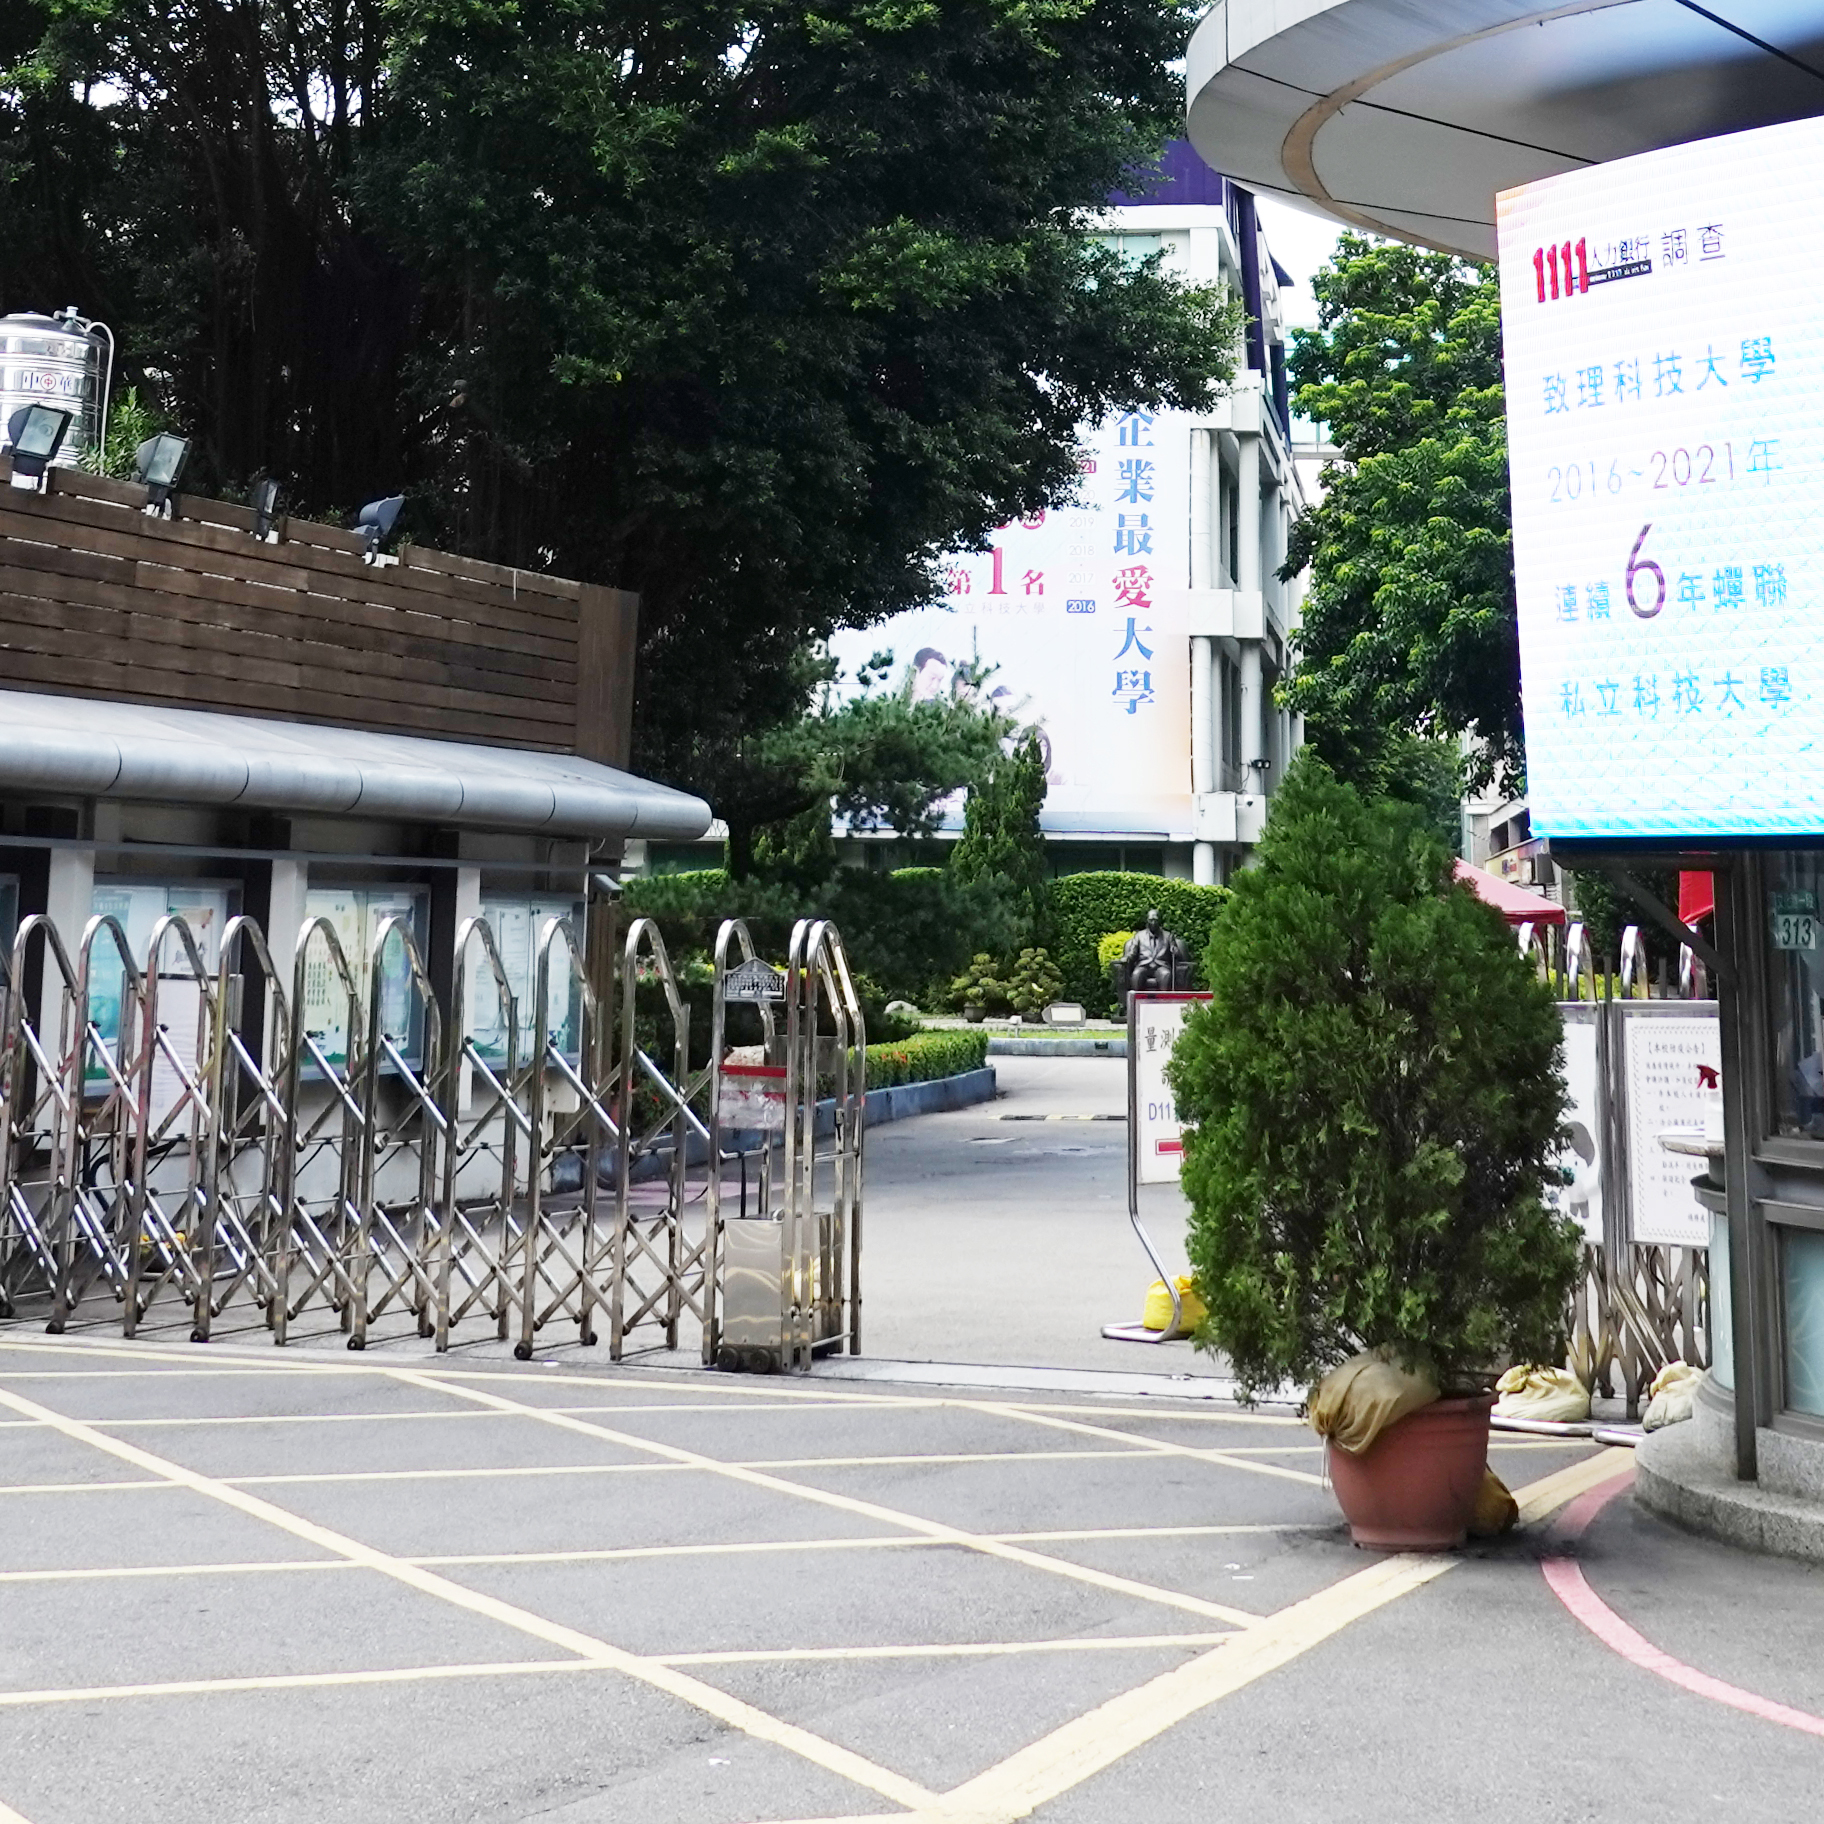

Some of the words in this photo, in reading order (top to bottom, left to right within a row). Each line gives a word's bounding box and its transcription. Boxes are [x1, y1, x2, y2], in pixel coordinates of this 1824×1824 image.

[1532, 236, 1589, 303] 1111
[1660, 222, 1726, 268] 調查
[1542, 336, 1776, 415] 致理科技大學
[1068, 516, 1095, 528] 2019
[1068, 545, 1095, 556] 2018
[1111, 410, 1156, 715] 企業最愛大學
[1067, 572, 1095, 584] 2017
[1067, 600, 1096, 613] 2016
[1559, 666, 1792, 720] 私立科技大學
[1781, 917, 1812, 946] 313
